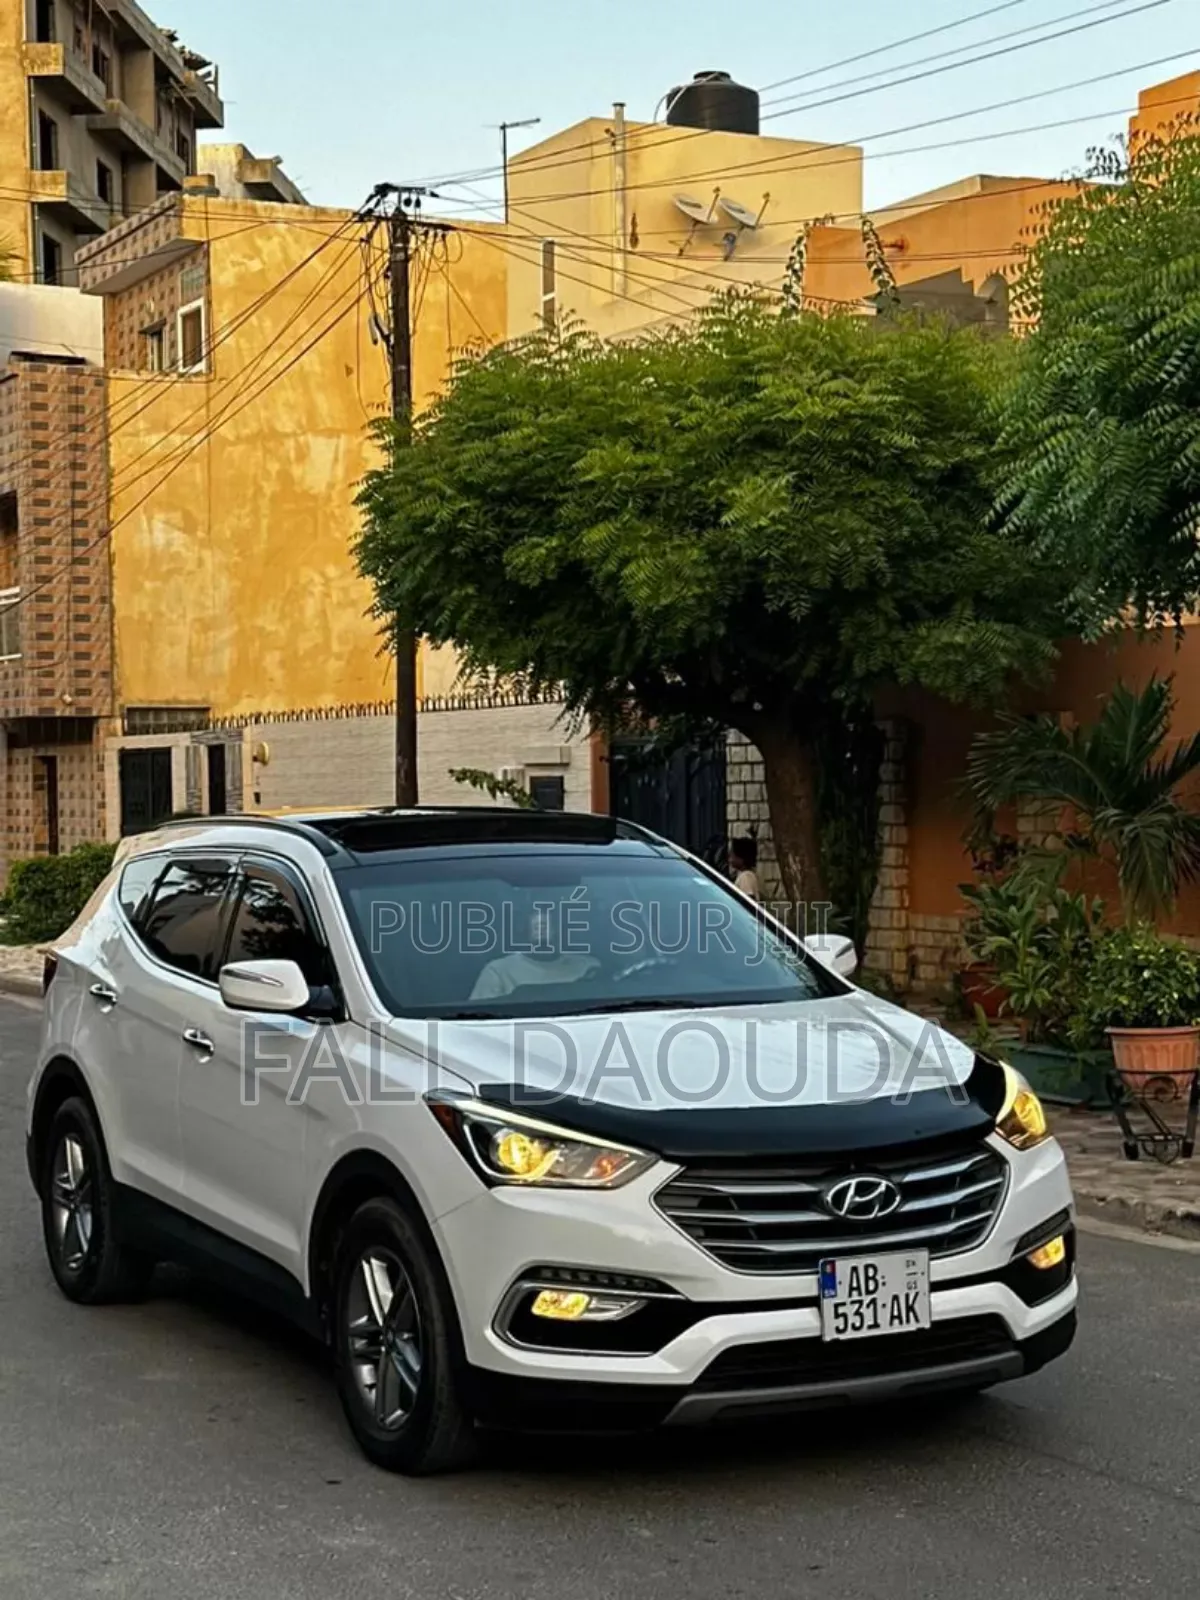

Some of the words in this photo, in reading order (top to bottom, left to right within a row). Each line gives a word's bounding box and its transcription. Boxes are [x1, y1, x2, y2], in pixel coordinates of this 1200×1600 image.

[848, 1263, 880, 1299] AB
[833, 1297, 881, 1335] 531
[889, 1291, 920, 1327] AK
